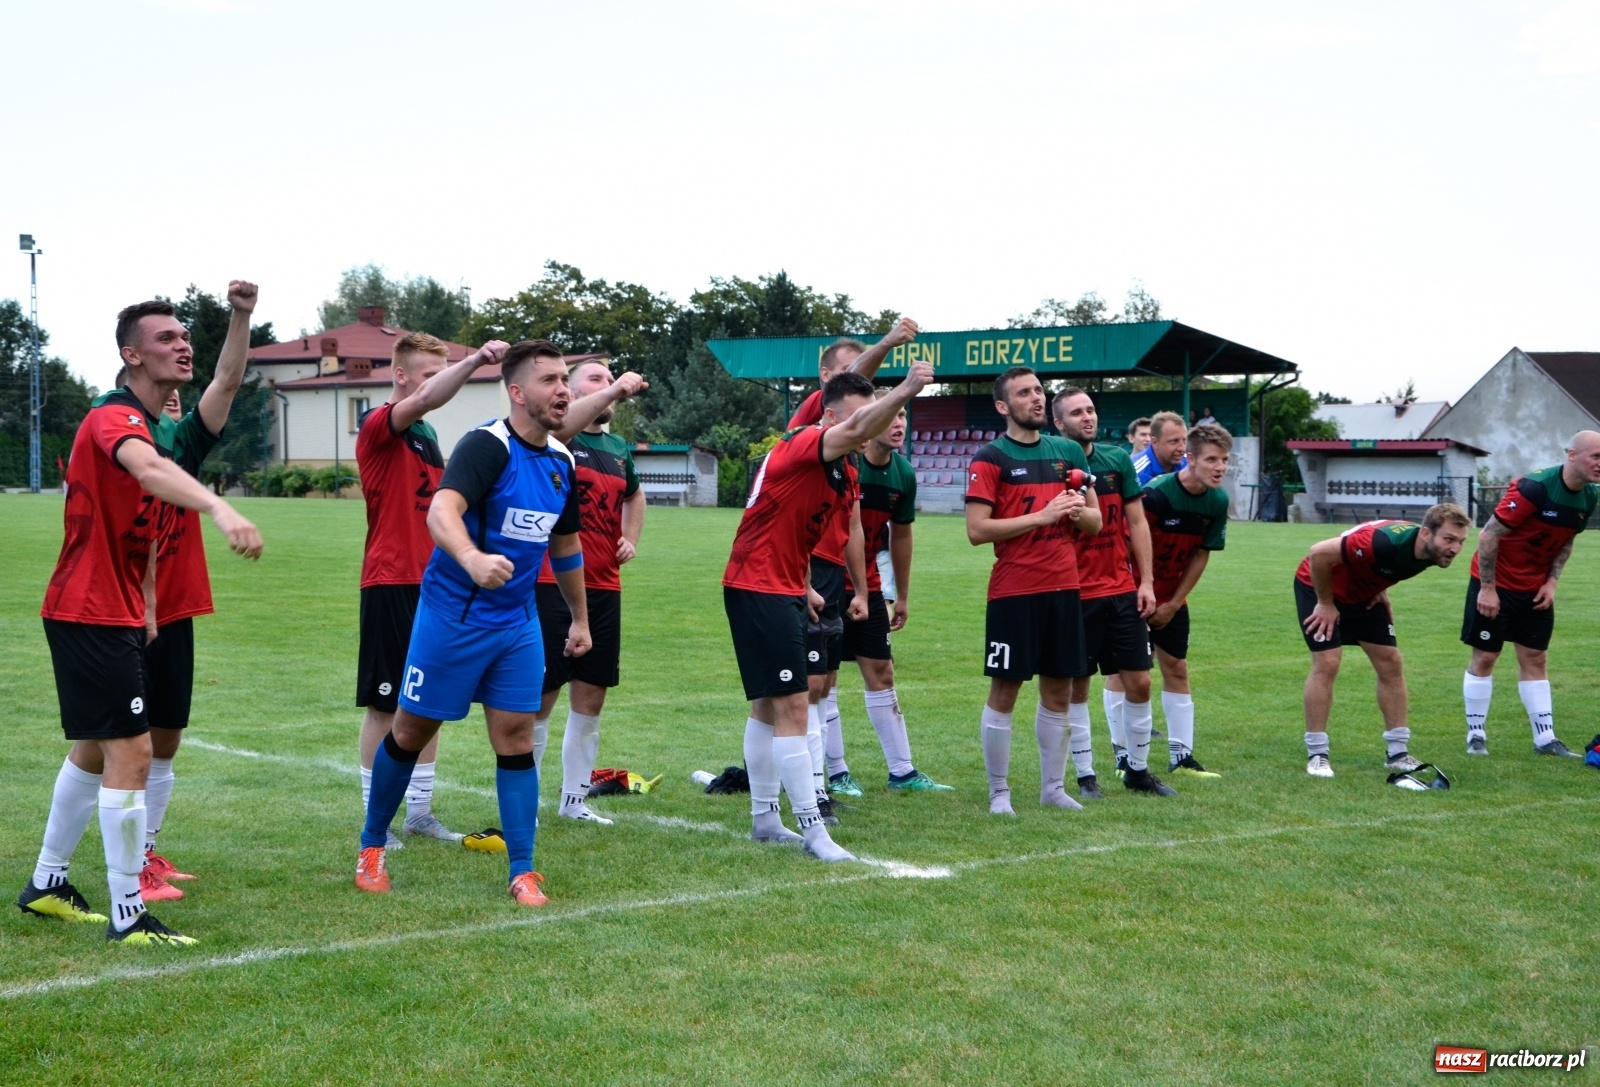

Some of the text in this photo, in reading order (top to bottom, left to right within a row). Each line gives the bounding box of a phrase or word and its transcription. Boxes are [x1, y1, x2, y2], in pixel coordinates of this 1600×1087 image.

[864, 342, 941, 369] ARNI
[966, 336, 1073, 366] GORZYCE
[403, 664, 424, 702] 12
